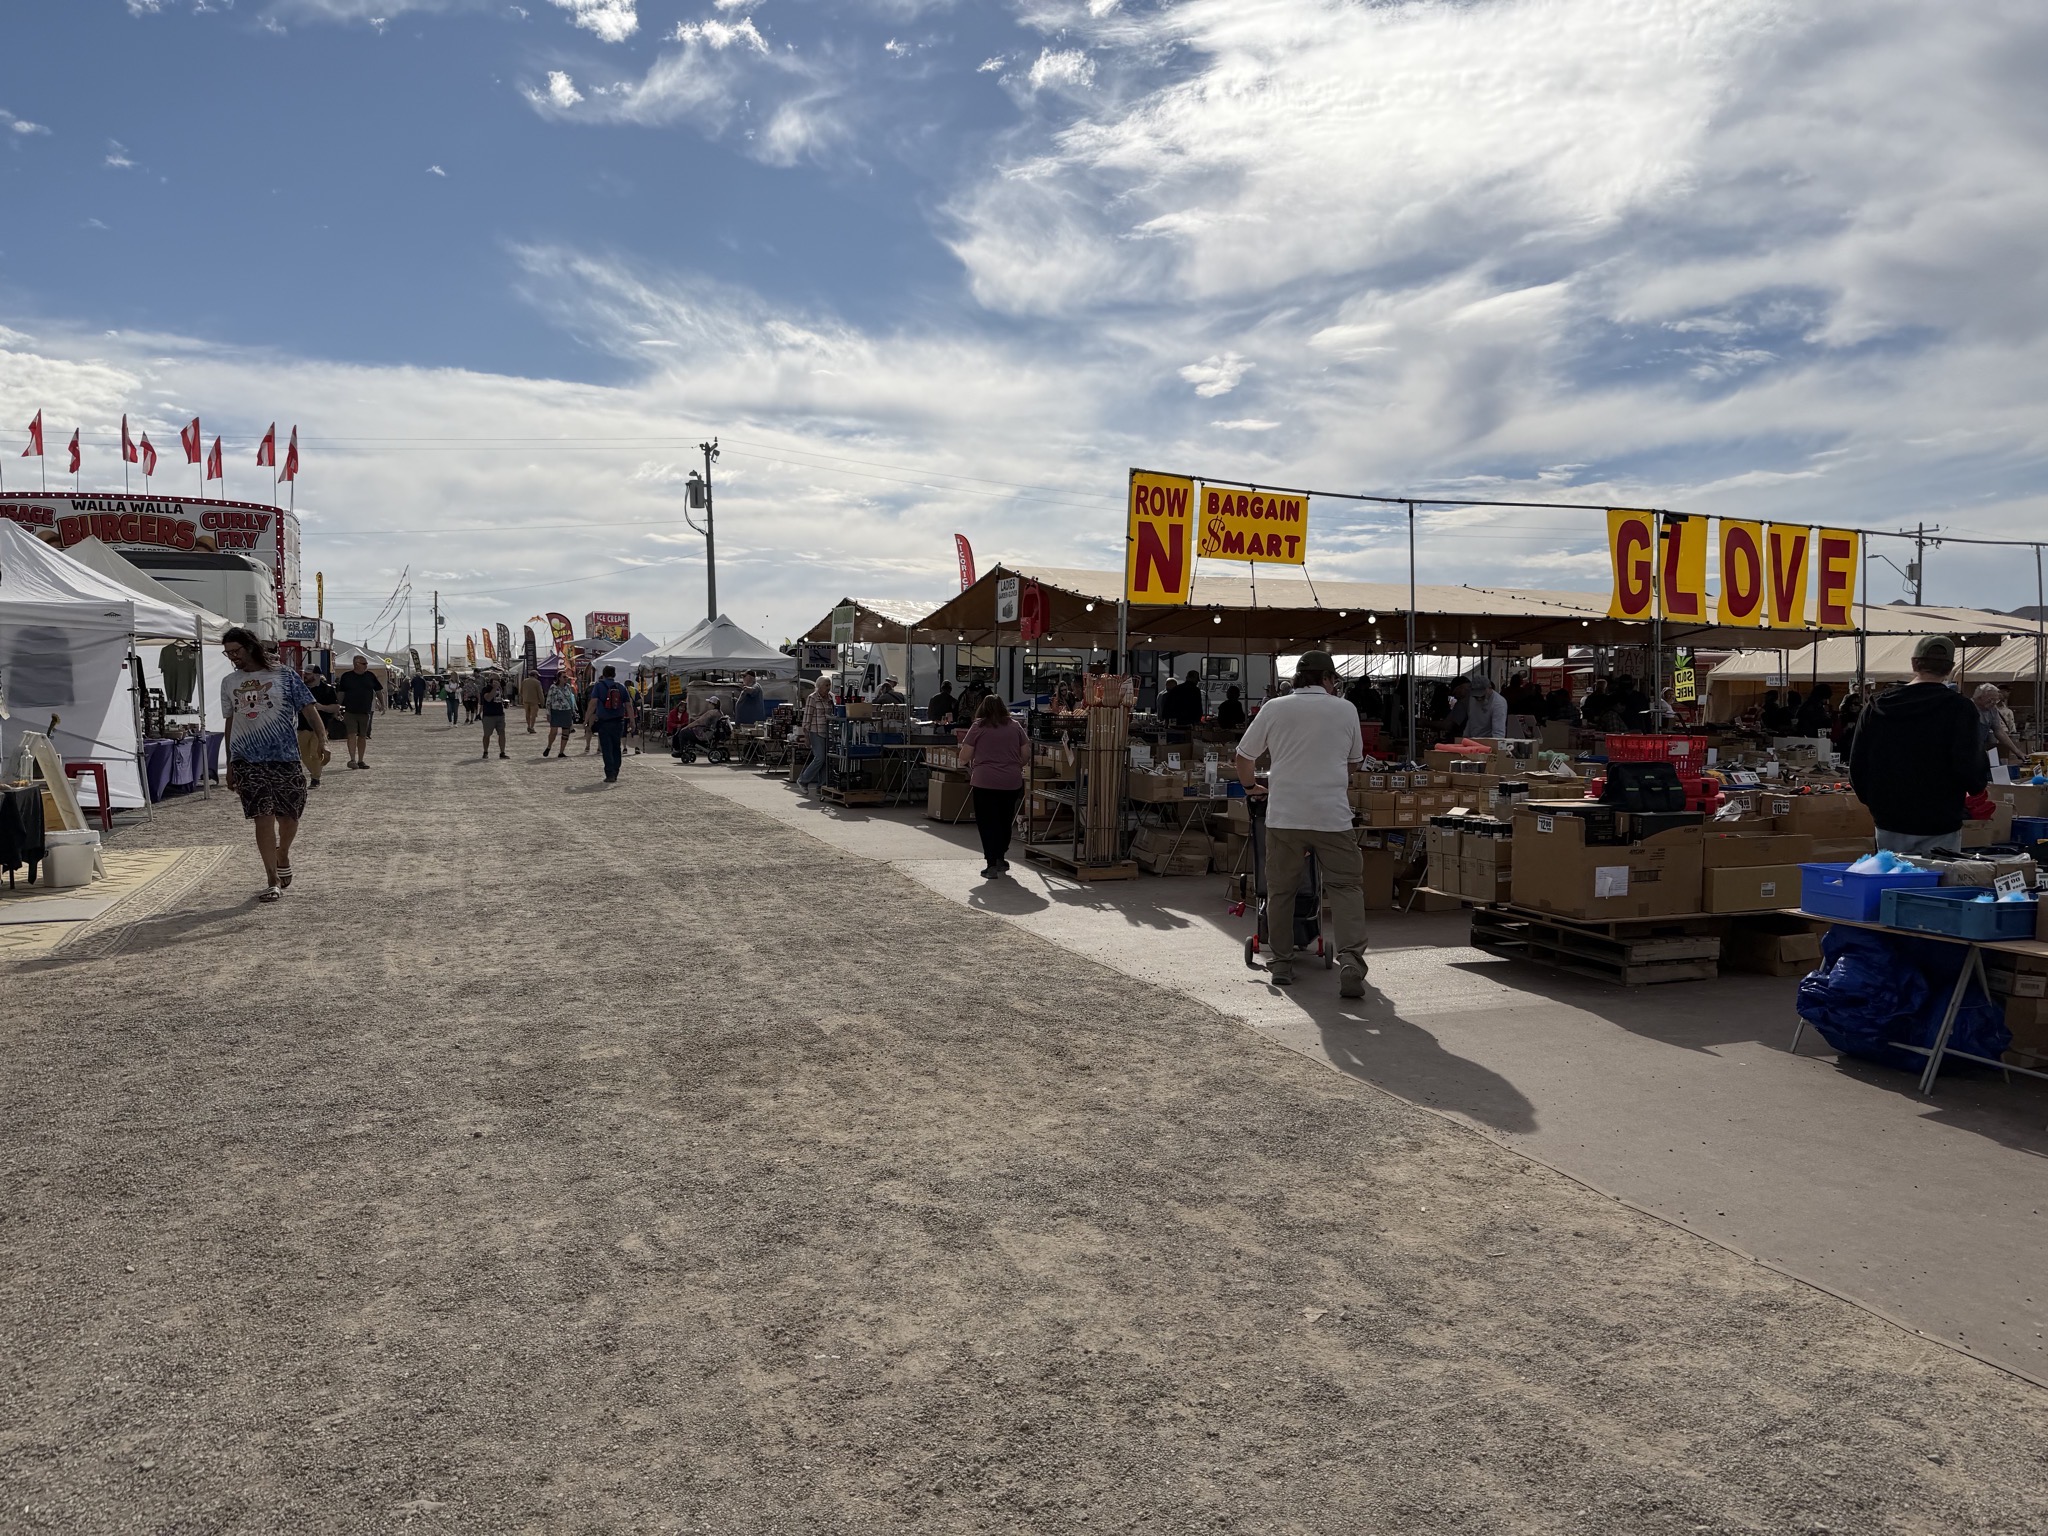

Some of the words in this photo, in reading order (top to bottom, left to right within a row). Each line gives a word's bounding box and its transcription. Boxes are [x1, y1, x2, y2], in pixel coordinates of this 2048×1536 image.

[71, 500, 127, 513] WALLA
[129, 501, 184, 514] WALLA
[1136, 485, 1188, 518] ROW
[1207, 492, 1300, 523] BARGAIN
[59, 513, 197, 550] BURGERS
[201, 512, 270, 531] CURLY
[1201, 515, 1301, 559] $MART
[216, 530, 258, 548] FRY
[1133, 520, 1184, 594] N
[1616, 519, 1852, 625] GLOVE
[608, 614, 626, 623] CREAM
